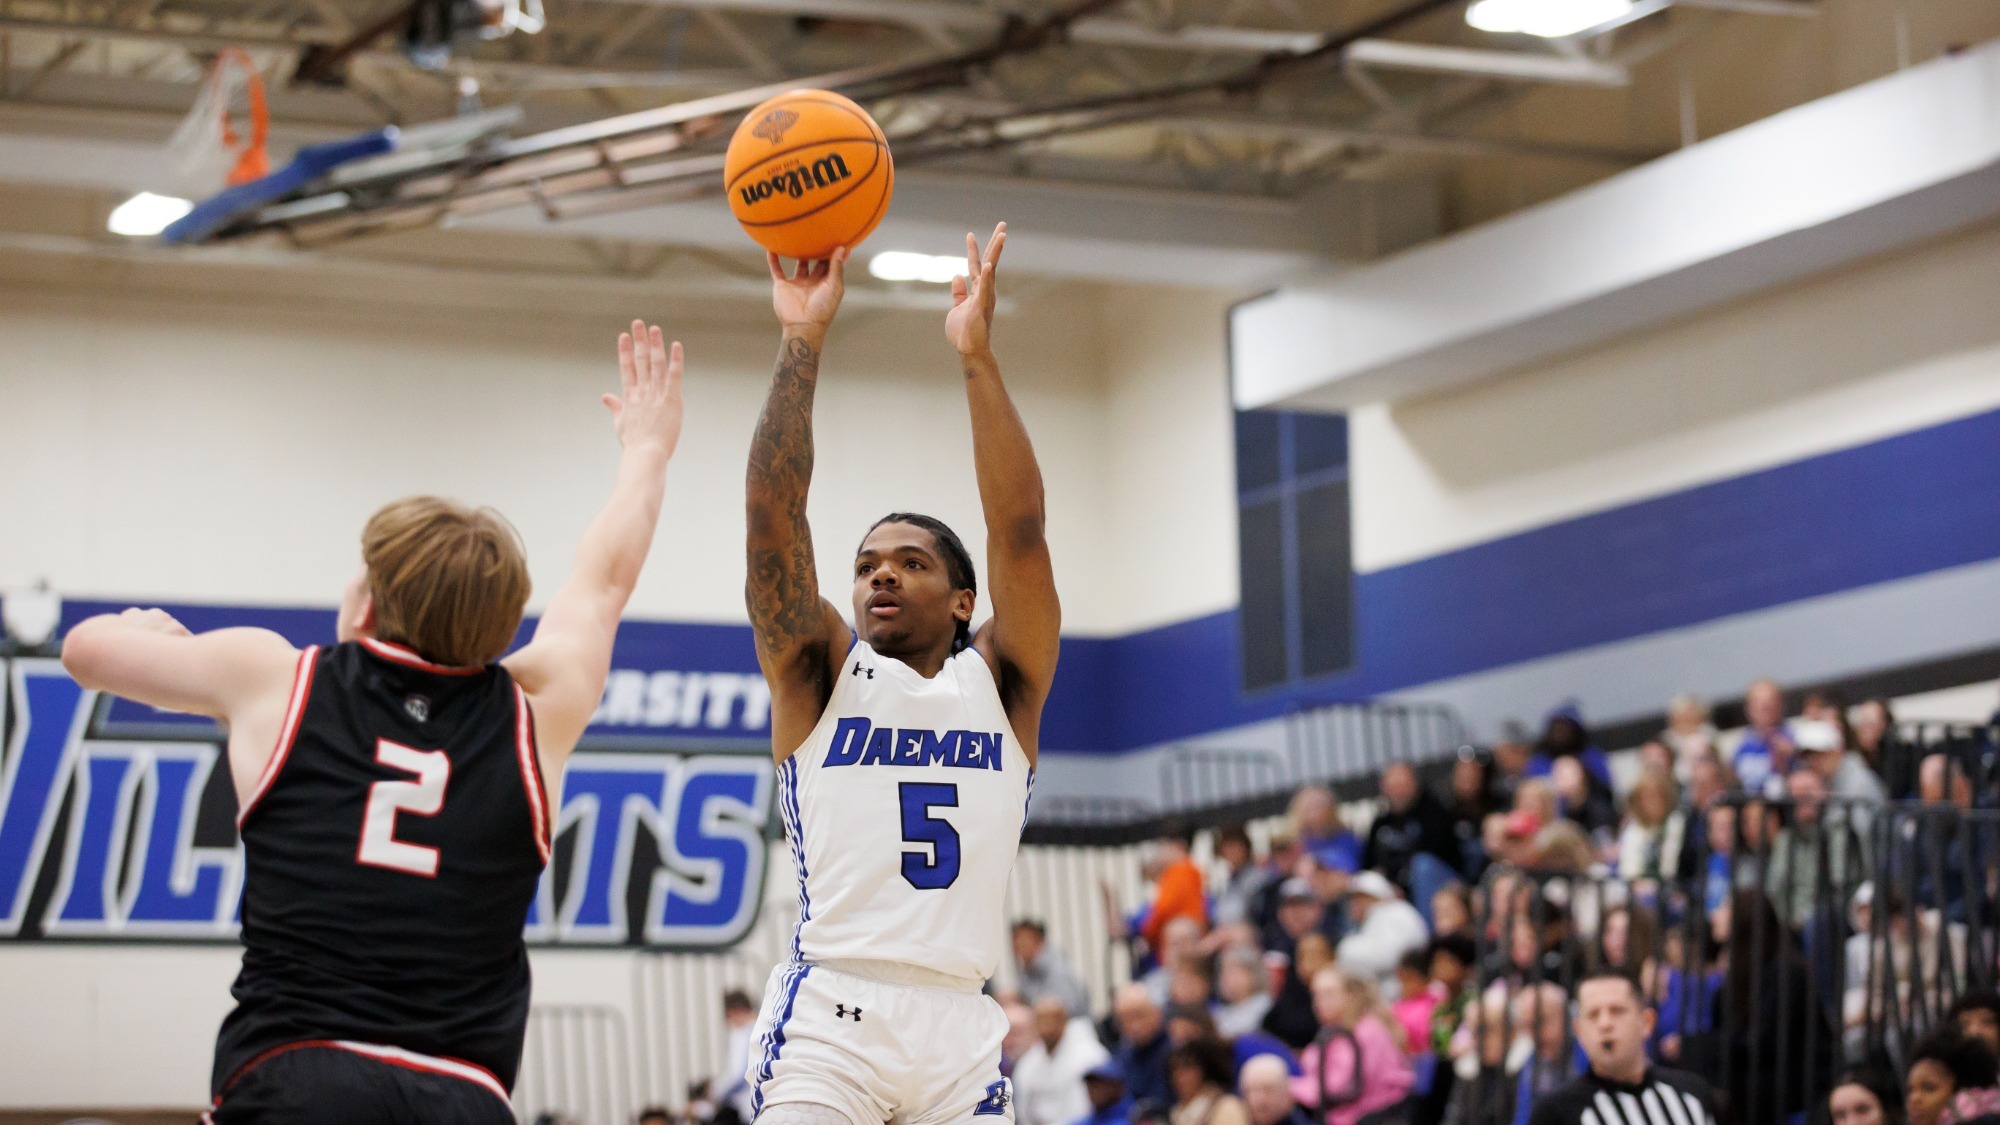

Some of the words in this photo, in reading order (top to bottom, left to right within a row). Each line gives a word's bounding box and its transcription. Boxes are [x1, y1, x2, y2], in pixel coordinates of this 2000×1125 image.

[740, 153, 852, 207] Wilson
[821, 716, 1003, 771] DAEMEN
[356, 736, 452, 879] 2
[898, 782, 961, 889] 5
